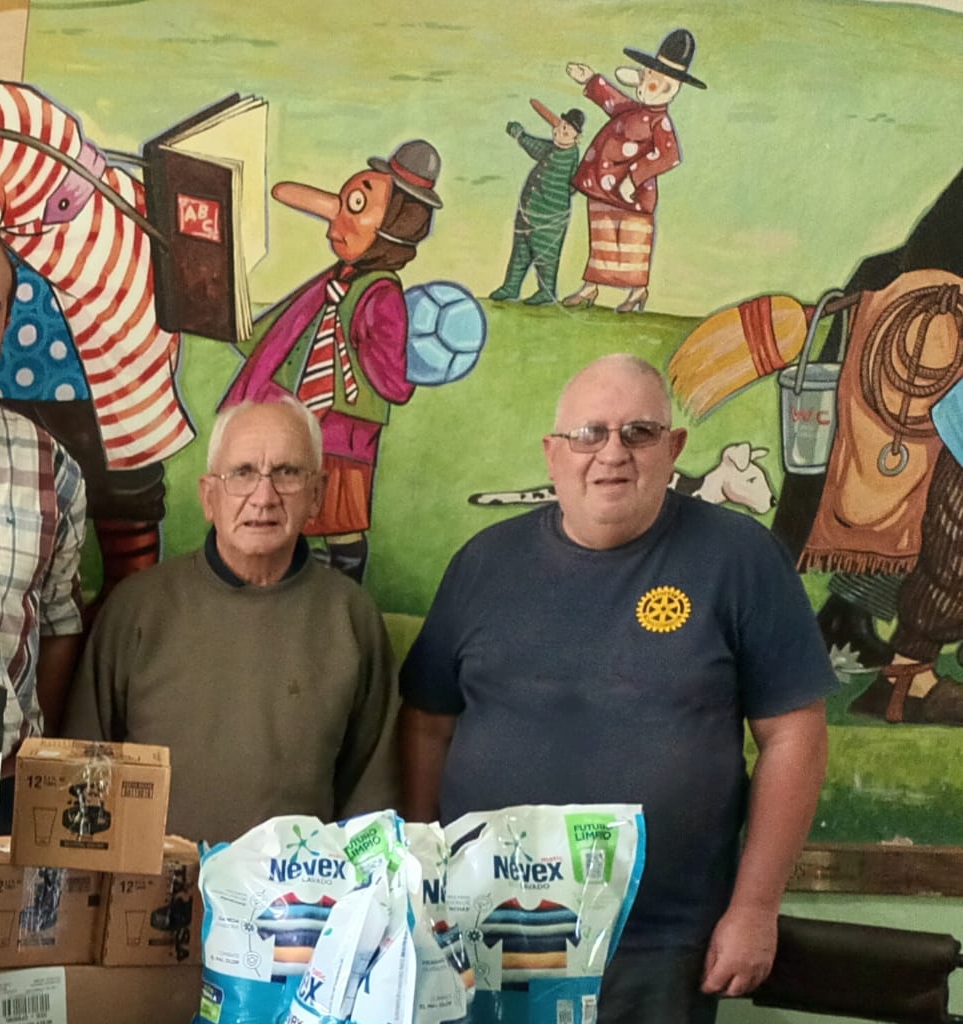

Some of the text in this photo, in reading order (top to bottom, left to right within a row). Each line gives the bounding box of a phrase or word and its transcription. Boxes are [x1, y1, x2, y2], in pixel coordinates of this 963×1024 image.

[27, 775, 43, 789] 12
[268, 857, 346, 883] Nevex
[493, 854, 564, 883] Nevex
[120, 880, 133, 893] 12
